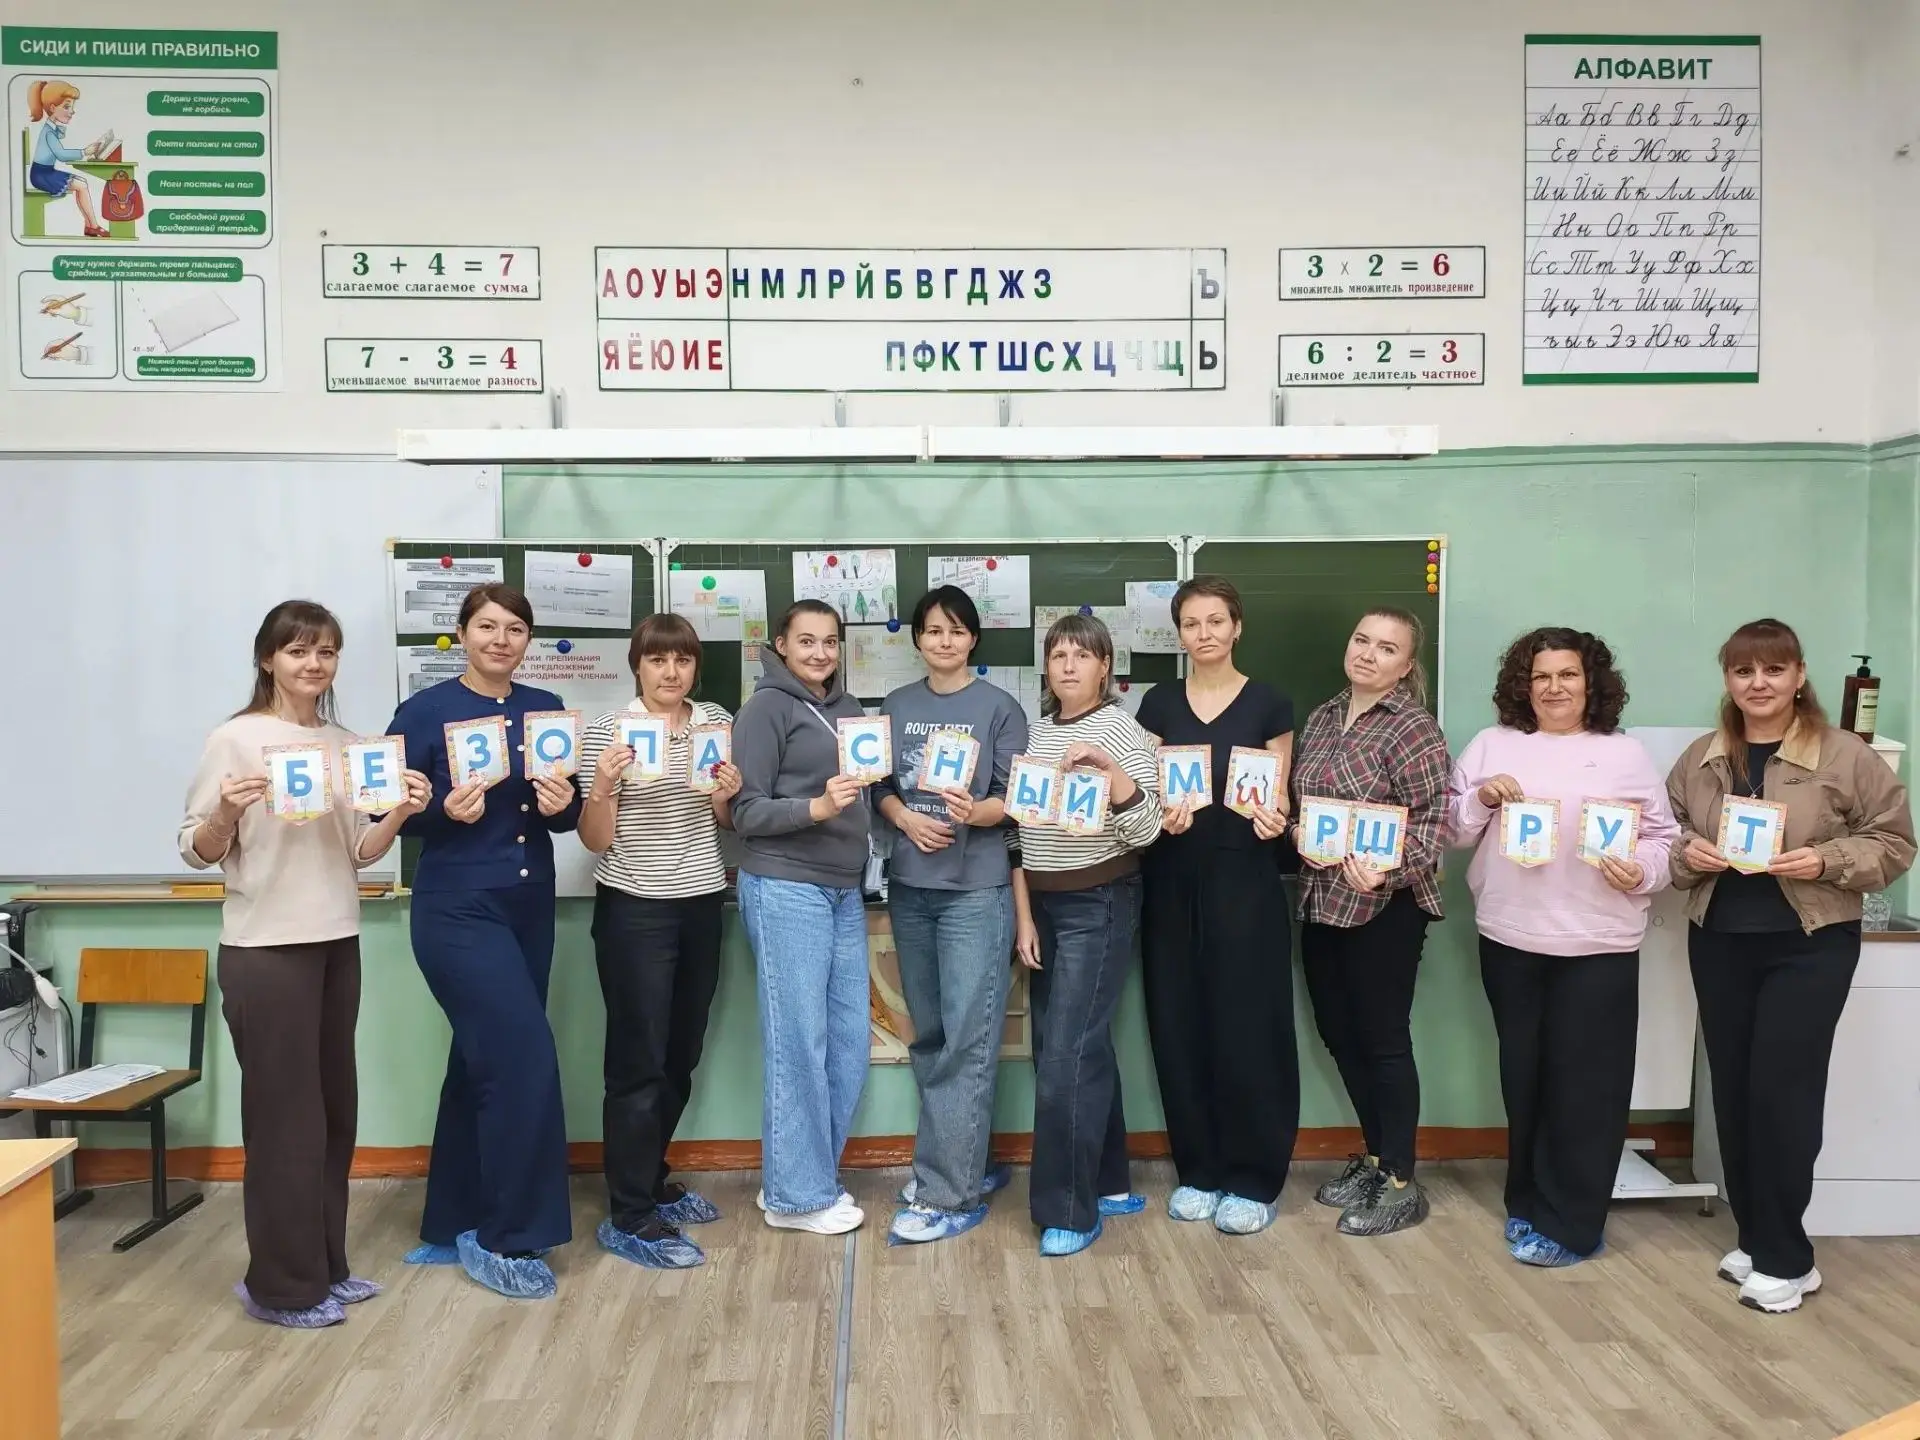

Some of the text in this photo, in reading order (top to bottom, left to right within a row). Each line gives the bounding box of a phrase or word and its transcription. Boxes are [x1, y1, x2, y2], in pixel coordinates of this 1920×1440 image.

[20, 40, 260, 58] СИДИ И ПИШИ ПРАВИЛЬНО
[1574, 58, 1713, 80] АЛФАВИТ
[156, 223, 259, 234] придерживай тетрадь
[169, 212, 245, 223] Свободной рукой
[353, 252, 515, 276] 3 + 4 = 7
[1308, 255, 1323, 278] 3
[1368, 254, 1383, 276] 2
[1401, 262, 1418, 271] =
[1433, 253, 1450, 276] 6
[326, 282, 528, 295] слагаемое слагаемое сумма
[1197, 269, 1219, 300] Ъ
[1290, 283, 1474, 295] множитель множитель произведение
[361, 346, 375, 368] 7
[437, 346, 454, 369] 3
[469, 355, 487, 366] =
[500, 346, 518, 370] 4
[1199, 340, 1218, 370] Ь
[1308, 340, 1458, 364] 6 : 2 = 3
[331, 377, 538, 389] уменьшаемое вычитаемое разность
[1285, 369, 1477, 382] делимое делитель частное
[905, 722, 941, 736] ROUTE
[466, 733, 491, 769] З
[535, 728, 572, 763] О
[629, 730, 656, 764] П
[697, 739, 721, 771] А
[850, 732, 881, 765] С
[364, 751, 388, 788] Е
[934, 745, 967, 781] Н
[286, 760, 313, 798] Б
[1017, 773, 1050, 809] Ы
[1168, 763, 1204, 795] М
[1067, 775, 1097, 818] Й
[1316, 815, 1338, 846] Р
[1355, 819, 1397, 855] Ш
[1520, 813, 1543, 846] Р
[1597, 816, 1624, 850] У
[1738, 815, 1767, 853] Т
